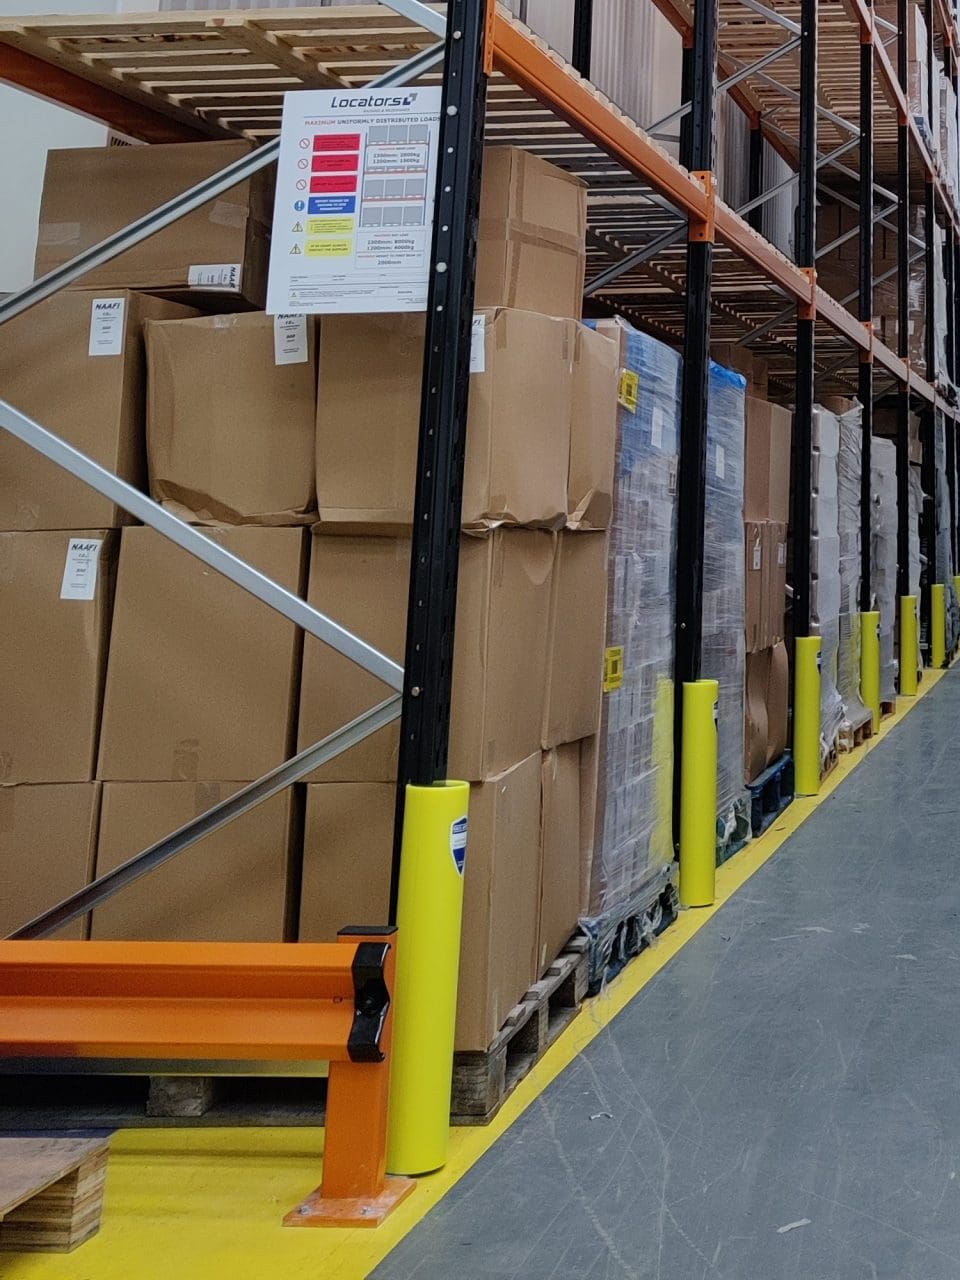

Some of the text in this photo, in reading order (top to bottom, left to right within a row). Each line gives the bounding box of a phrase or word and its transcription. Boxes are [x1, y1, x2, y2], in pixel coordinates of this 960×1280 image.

[331, 95, 402, 108] Locators
[375, 116, 419, 124] DISTRIBUTED
[71, 543, 98, 551] NAAFI
